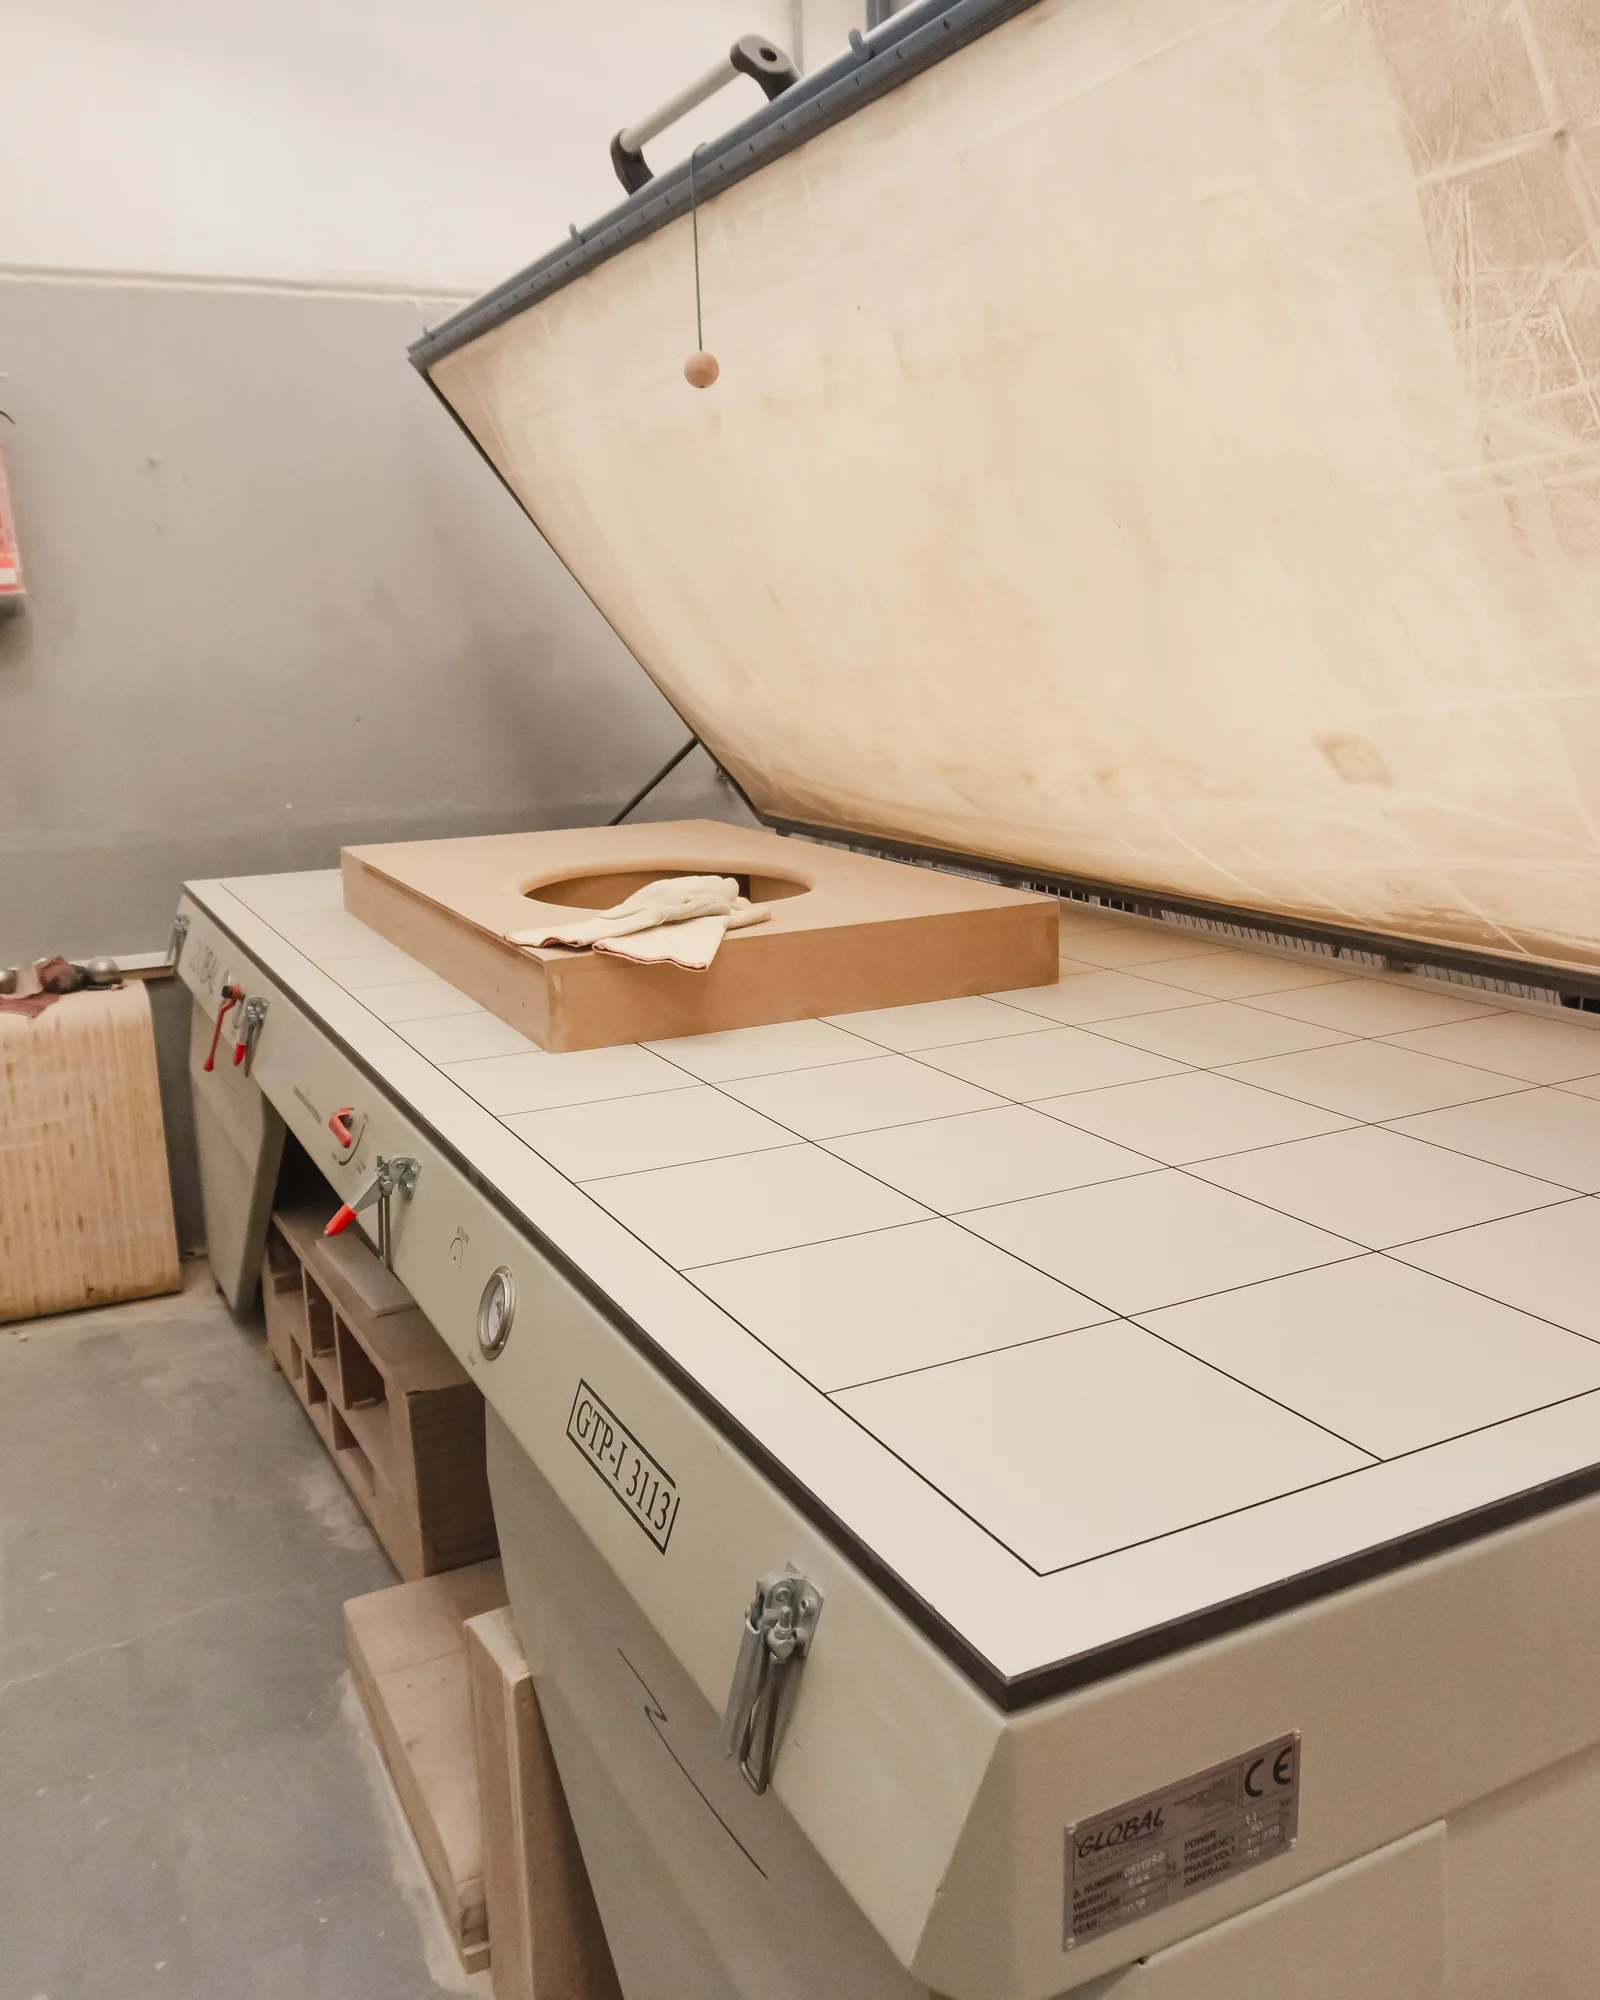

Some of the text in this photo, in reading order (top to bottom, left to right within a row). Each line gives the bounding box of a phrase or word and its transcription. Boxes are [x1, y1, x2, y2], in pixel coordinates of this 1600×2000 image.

[576, 1399, 671, 1531] GTP-I 3113
[1076, 1807, 1165, 1859] GLOBAL
